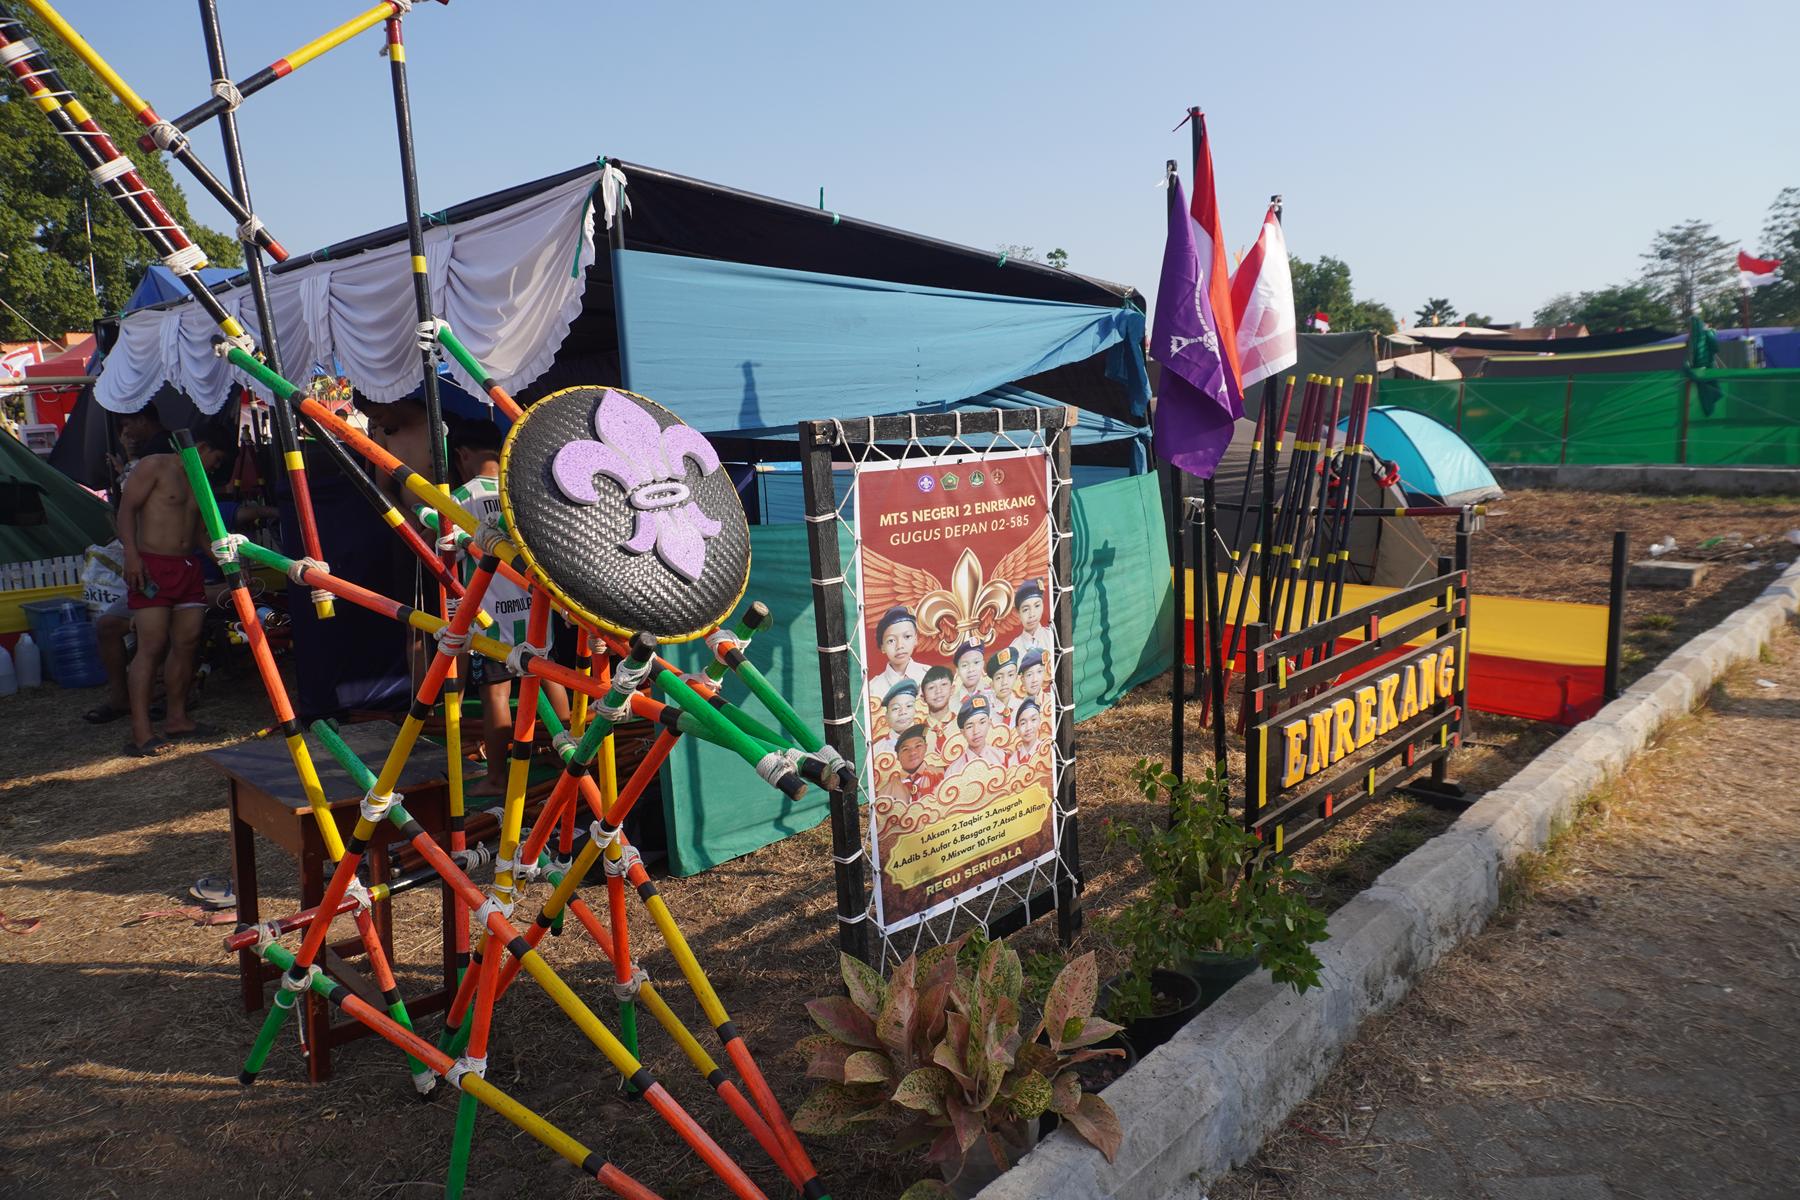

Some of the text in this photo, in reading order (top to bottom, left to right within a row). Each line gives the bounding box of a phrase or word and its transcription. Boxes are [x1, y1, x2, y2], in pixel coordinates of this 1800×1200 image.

[880, 495, 1036, 527] MTS NEGERI 2 ENREKANG
[890, 514, 1029, 546] GUGUS DEPAN 02-585
[1281, 645, 1455, 789] ENREKANG
[893, 802, 1046, 869] 4.Adib 5.Aufar 6.Basgara 7.Atsal 8.Alfian
[921, 798, 1023, 844] 1.Aksan 2.Taqbir 3.Anugrah
[940, 829, 1006, 864] 9.Miswar 10.Farid
[926, 846, 1022, 897] REGU SERIGALA
